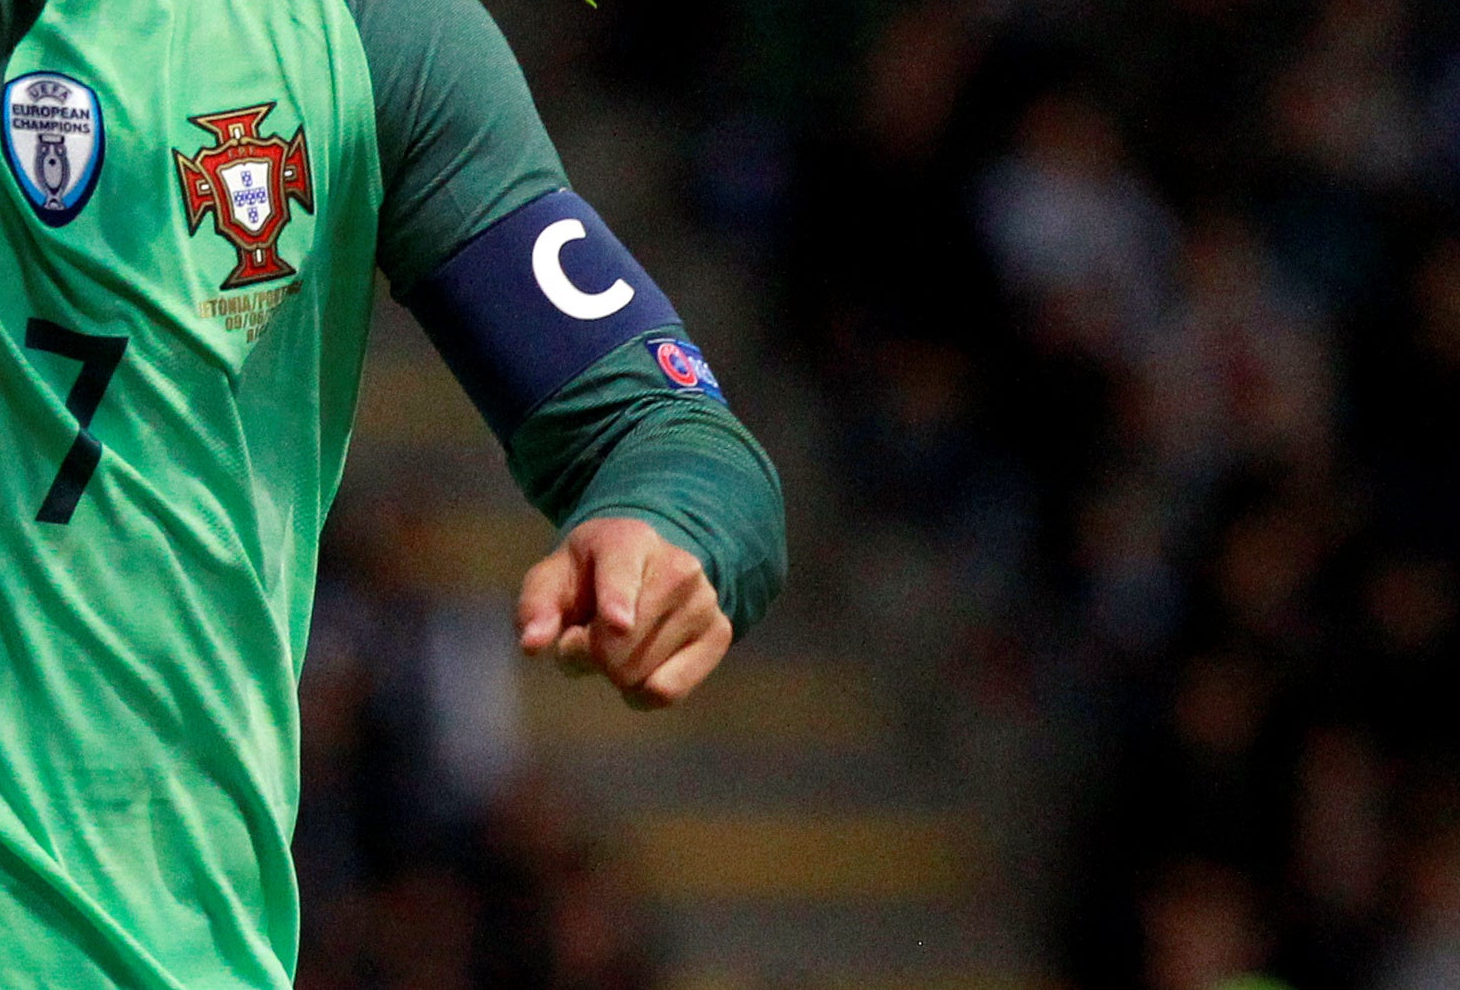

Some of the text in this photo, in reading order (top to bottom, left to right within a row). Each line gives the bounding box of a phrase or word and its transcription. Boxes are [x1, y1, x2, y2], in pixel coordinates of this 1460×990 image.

[28, 83, 69, 100] UEFA
[12, 103, 90, 120] EUROPEAN
[13, 118, 91, 133] CHAMPIONS
[532, 218, 635, 320] C
[24, 317, 130, 525] 7
